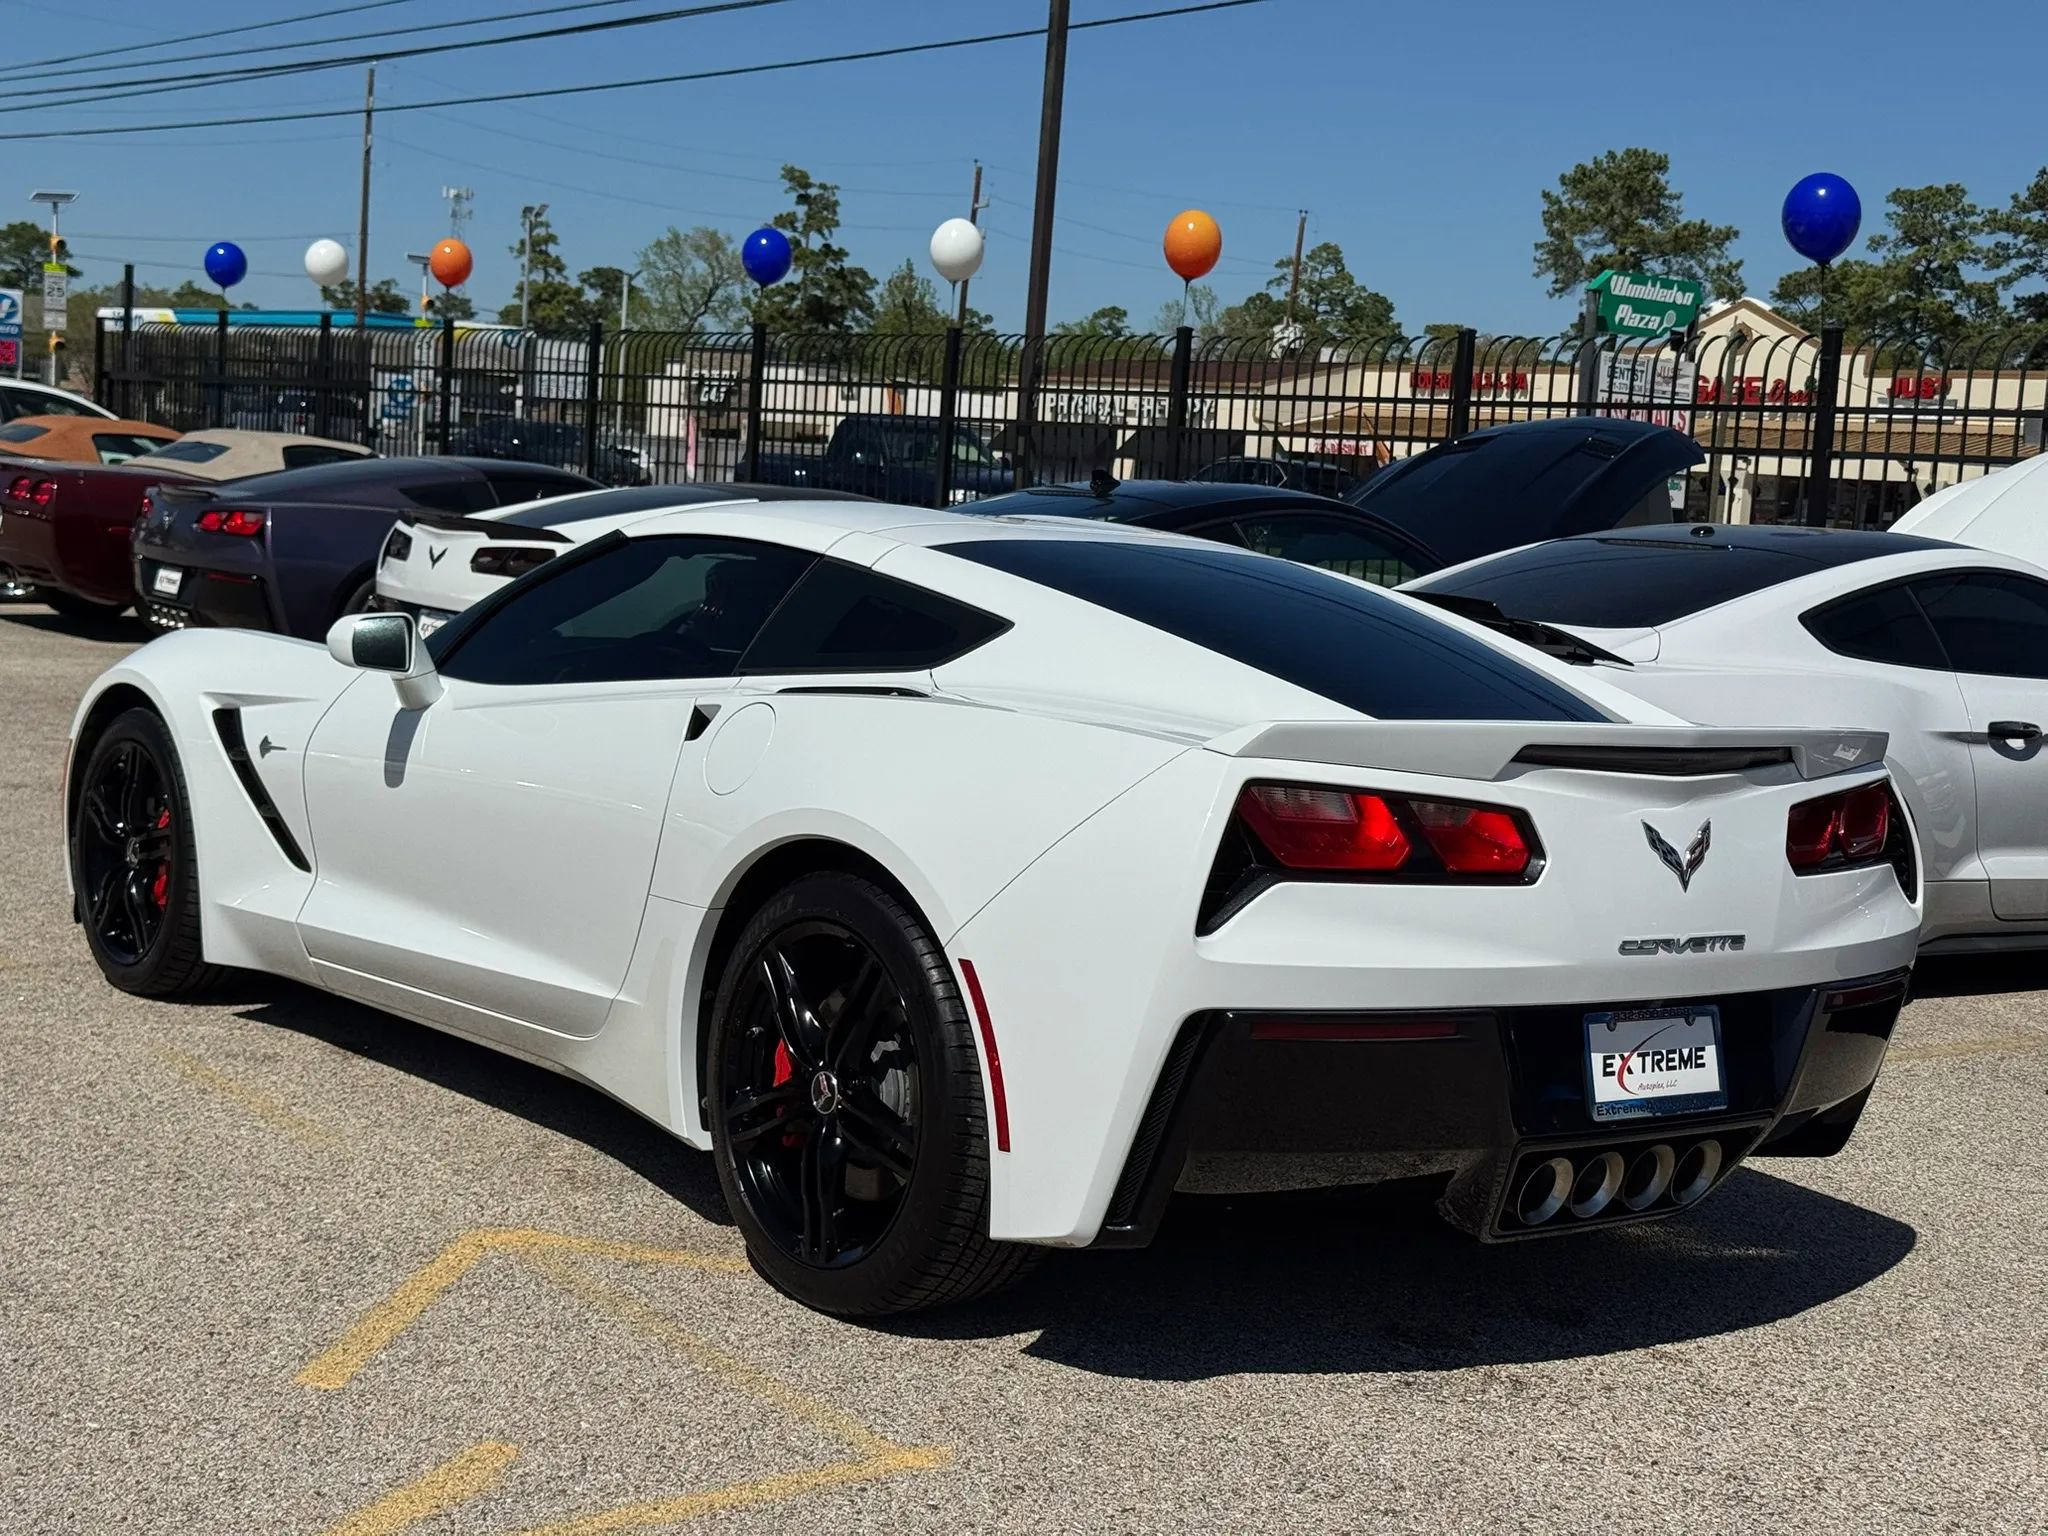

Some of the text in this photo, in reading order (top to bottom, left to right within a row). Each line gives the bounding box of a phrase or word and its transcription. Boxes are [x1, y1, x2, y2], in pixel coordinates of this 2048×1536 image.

[1610, 275, 1695, 306] Wimbledon
[1615, 304, 1662, 330] Plaza
[1607, 366, 1645, 383] DENTST
[1618, 935, 1746, 956] CORVETTE
[1602, 1046, 1706, 1078] EXTREME
